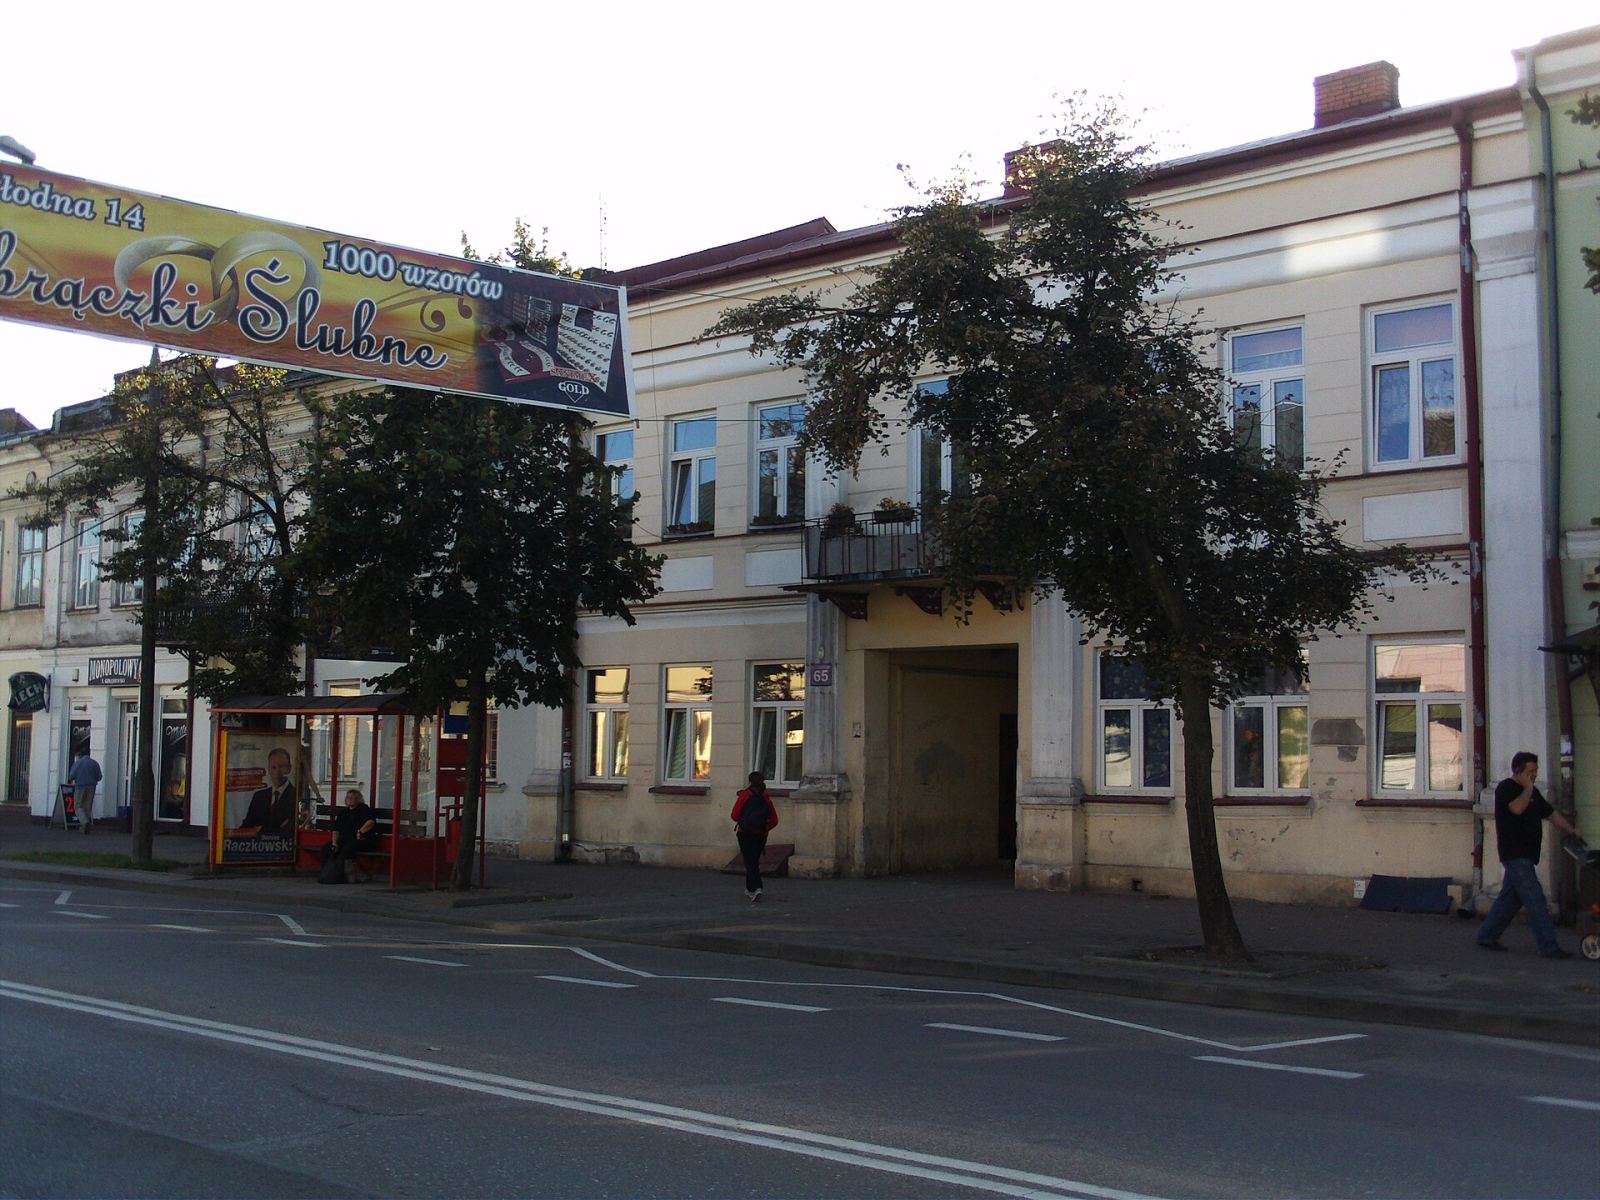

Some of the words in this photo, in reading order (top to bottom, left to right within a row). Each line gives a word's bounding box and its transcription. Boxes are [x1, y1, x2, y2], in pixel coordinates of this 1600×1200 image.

[104, 198, 145, 232] 14
[322, 239, 397, 281] 1000
[397, 260, 503, 301] wzorów
[238, 257, 448, 370] Ślubne
[558, 382, 590, 395] GOLD
[89, 658, 139, 681] MONOPOLOWY
[813, 669, 829, 682] 65
[14, 681, 43, 706] LECH
[224, 838, 293, 853] Raczkowski
